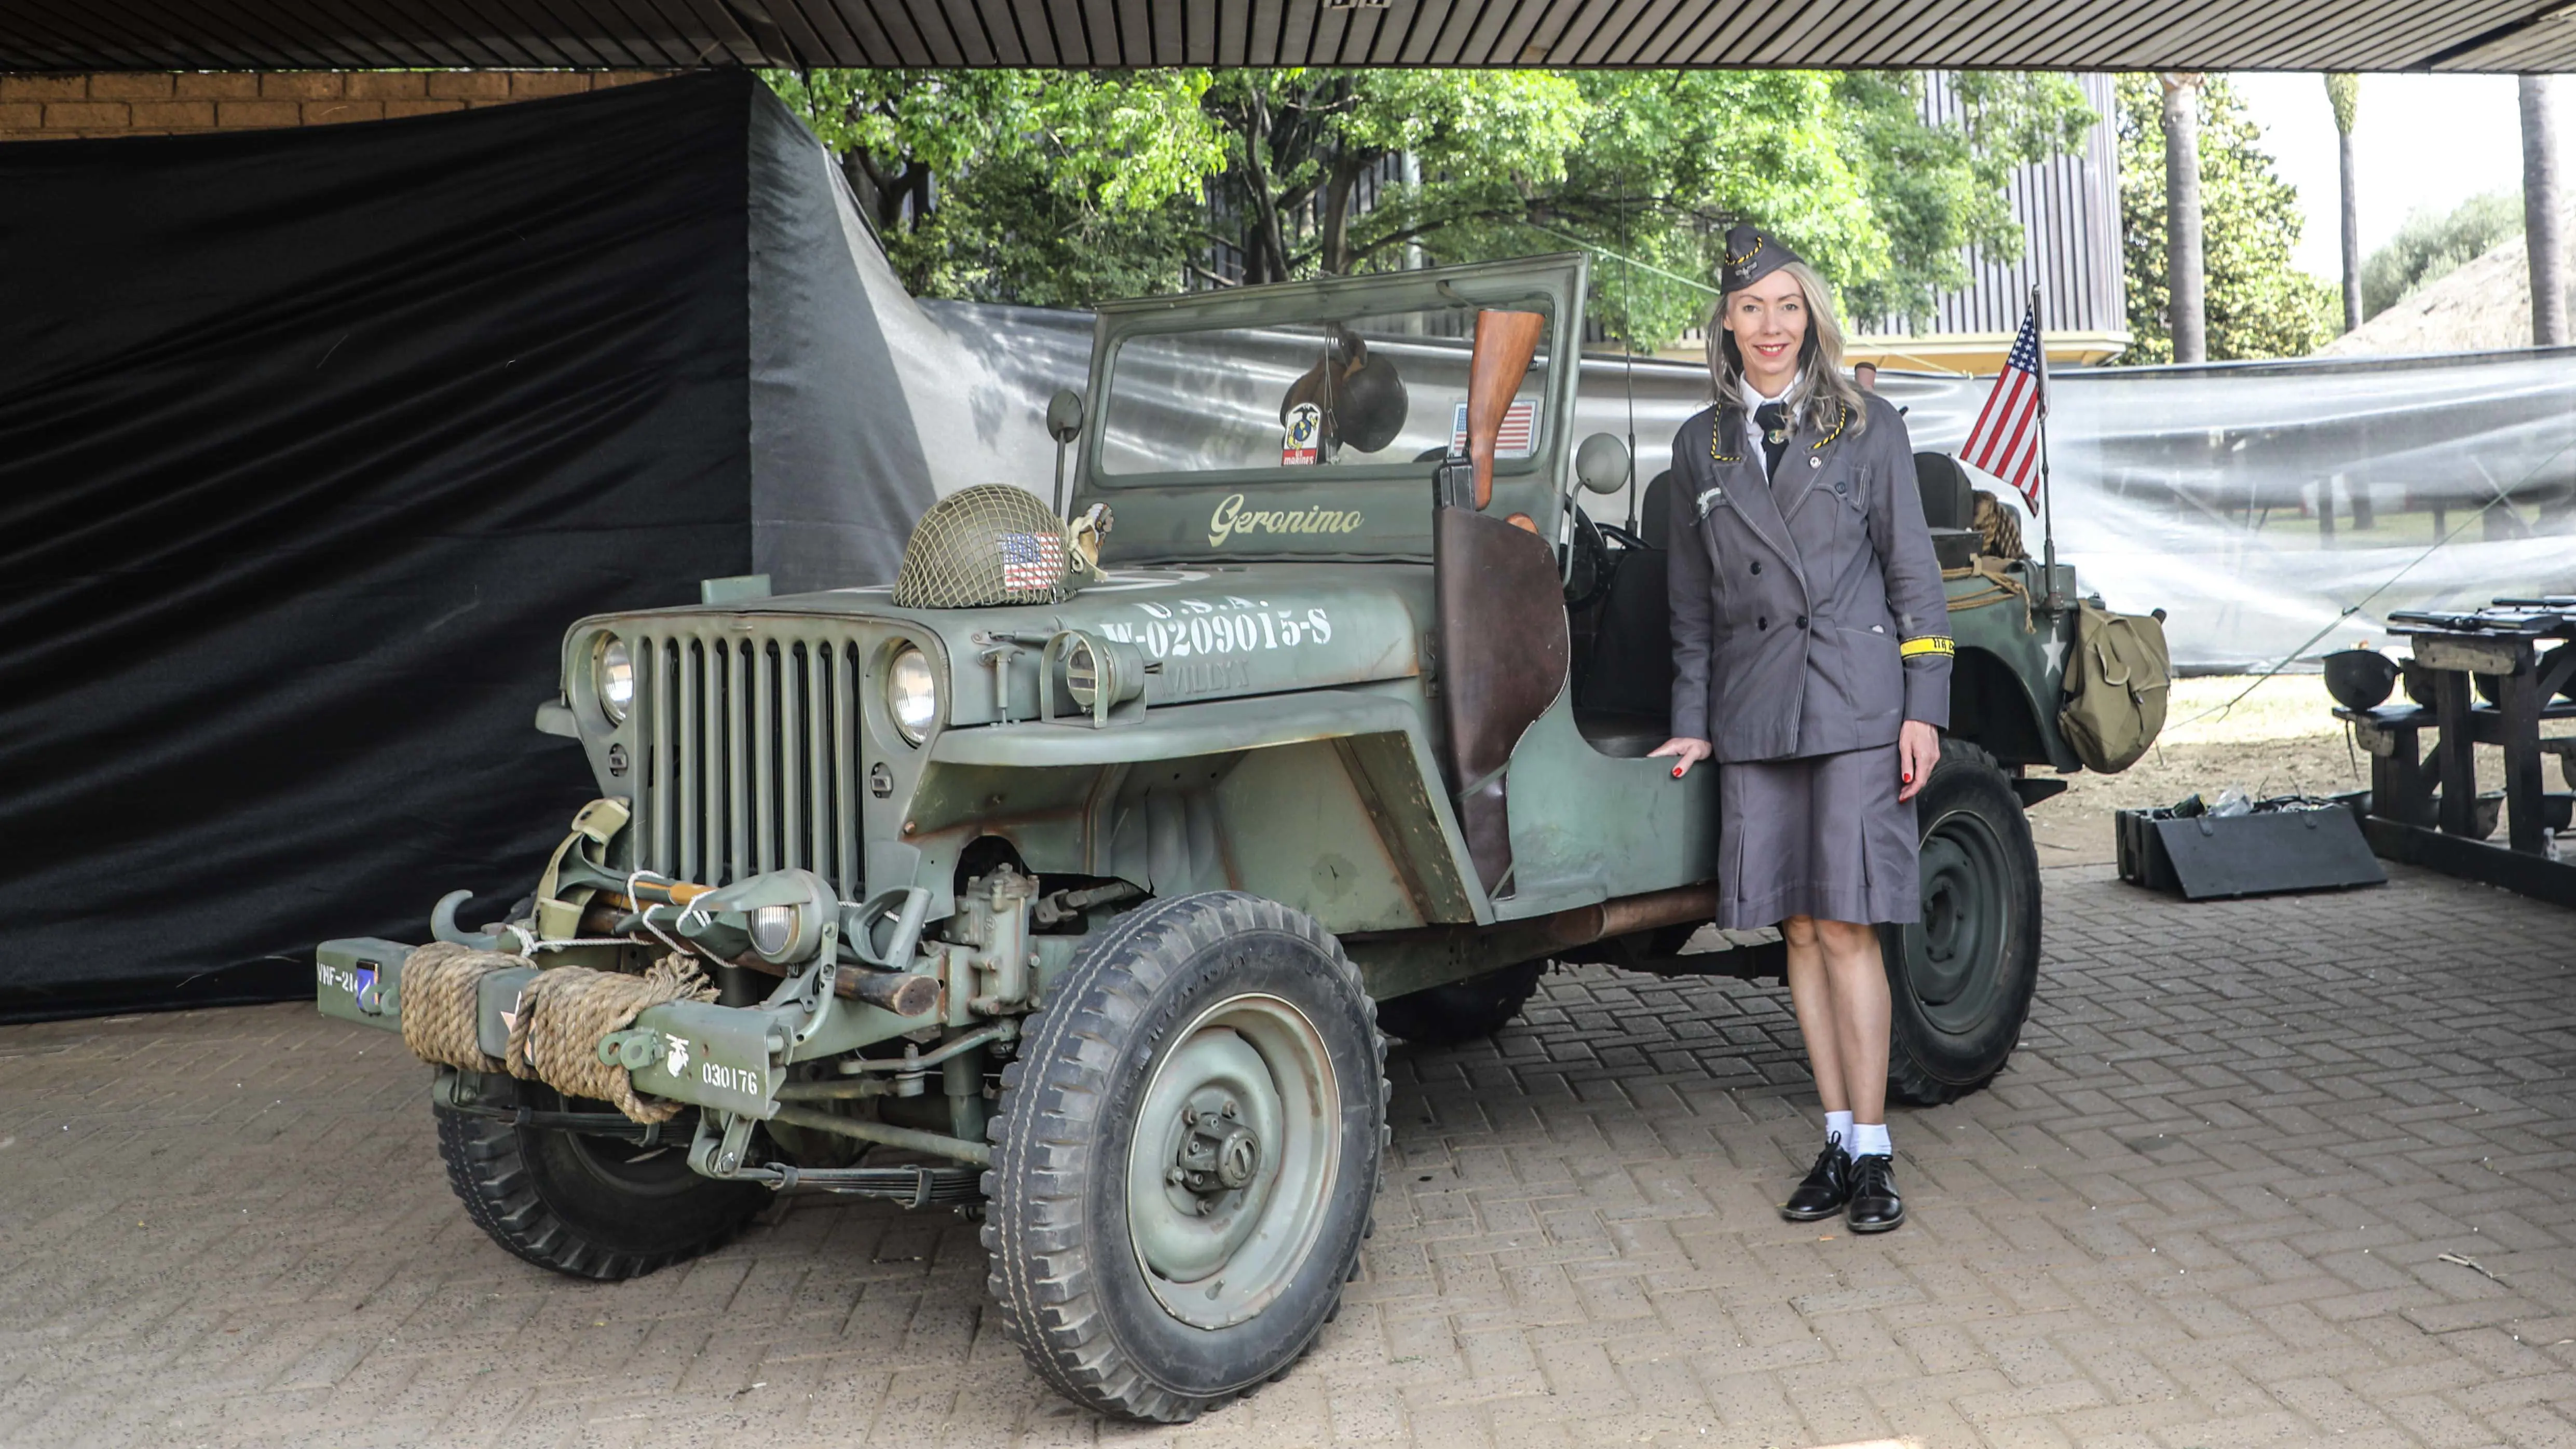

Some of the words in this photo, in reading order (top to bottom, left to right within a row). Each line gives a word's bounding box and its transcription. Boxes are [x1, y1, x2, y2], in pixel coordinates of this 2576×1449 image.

[1208, 494, 1364, 547] Geronimo
[1132, 595, 1269, 619] U.S.A.
[702, 1062, 757, 1095] 030176
